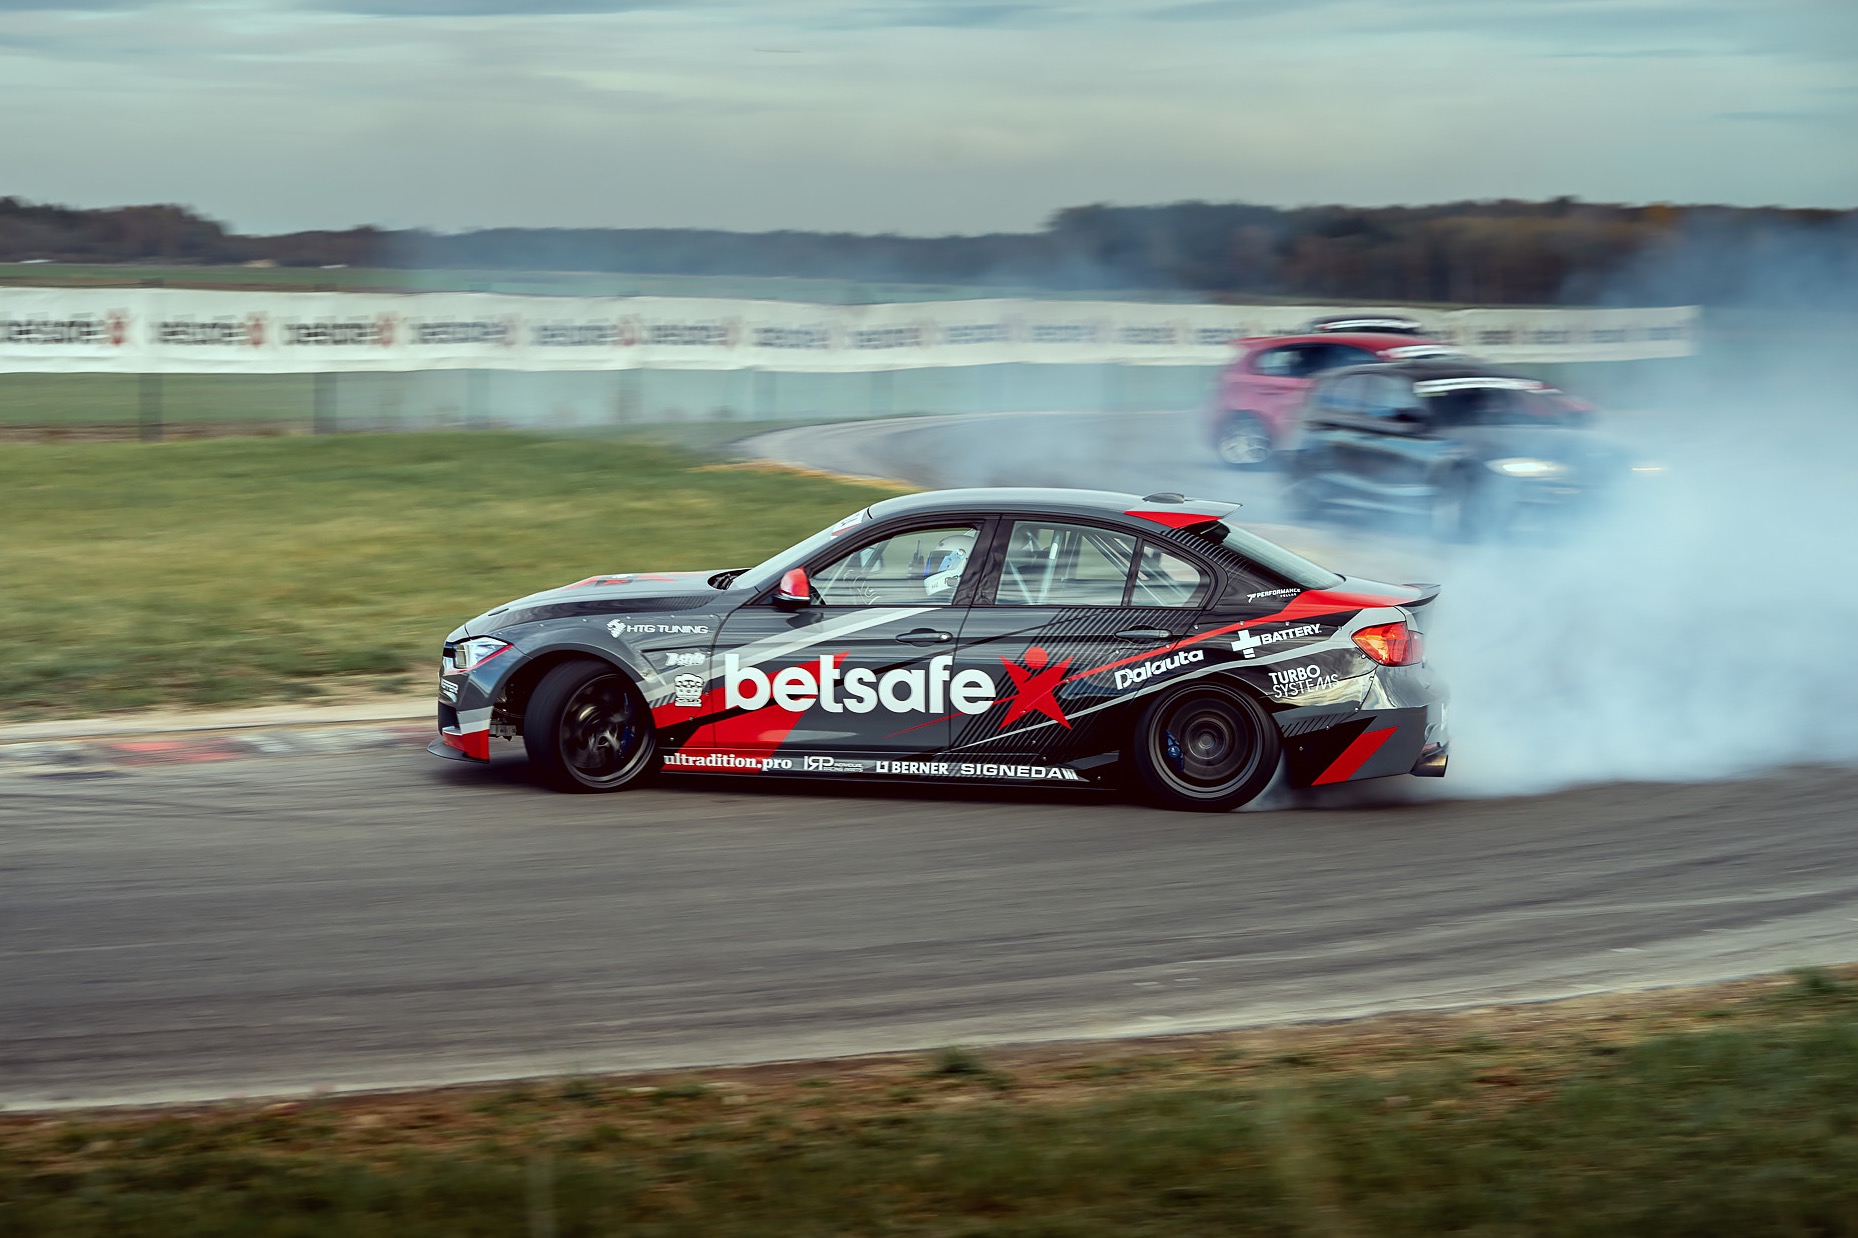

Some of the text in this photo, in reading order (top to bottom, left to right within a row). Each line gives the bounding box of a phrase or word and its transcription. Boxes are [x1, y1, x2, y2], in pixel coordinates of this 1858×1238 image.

[626, 625, 709, 634] HTG TUNING
[1114, 650, 1204, 690] Dalauta
[1269, 664, 1320, 685] TURBO
[725, 654, 996, 715] betsafe
[1272, 673, 1339, 699] SYSTEMS
[663, 753, 792, 771] ultradition.pro
[892, 761, 949, 774] BERNER
[960, 763, 1062, 779] SIGNEDA
